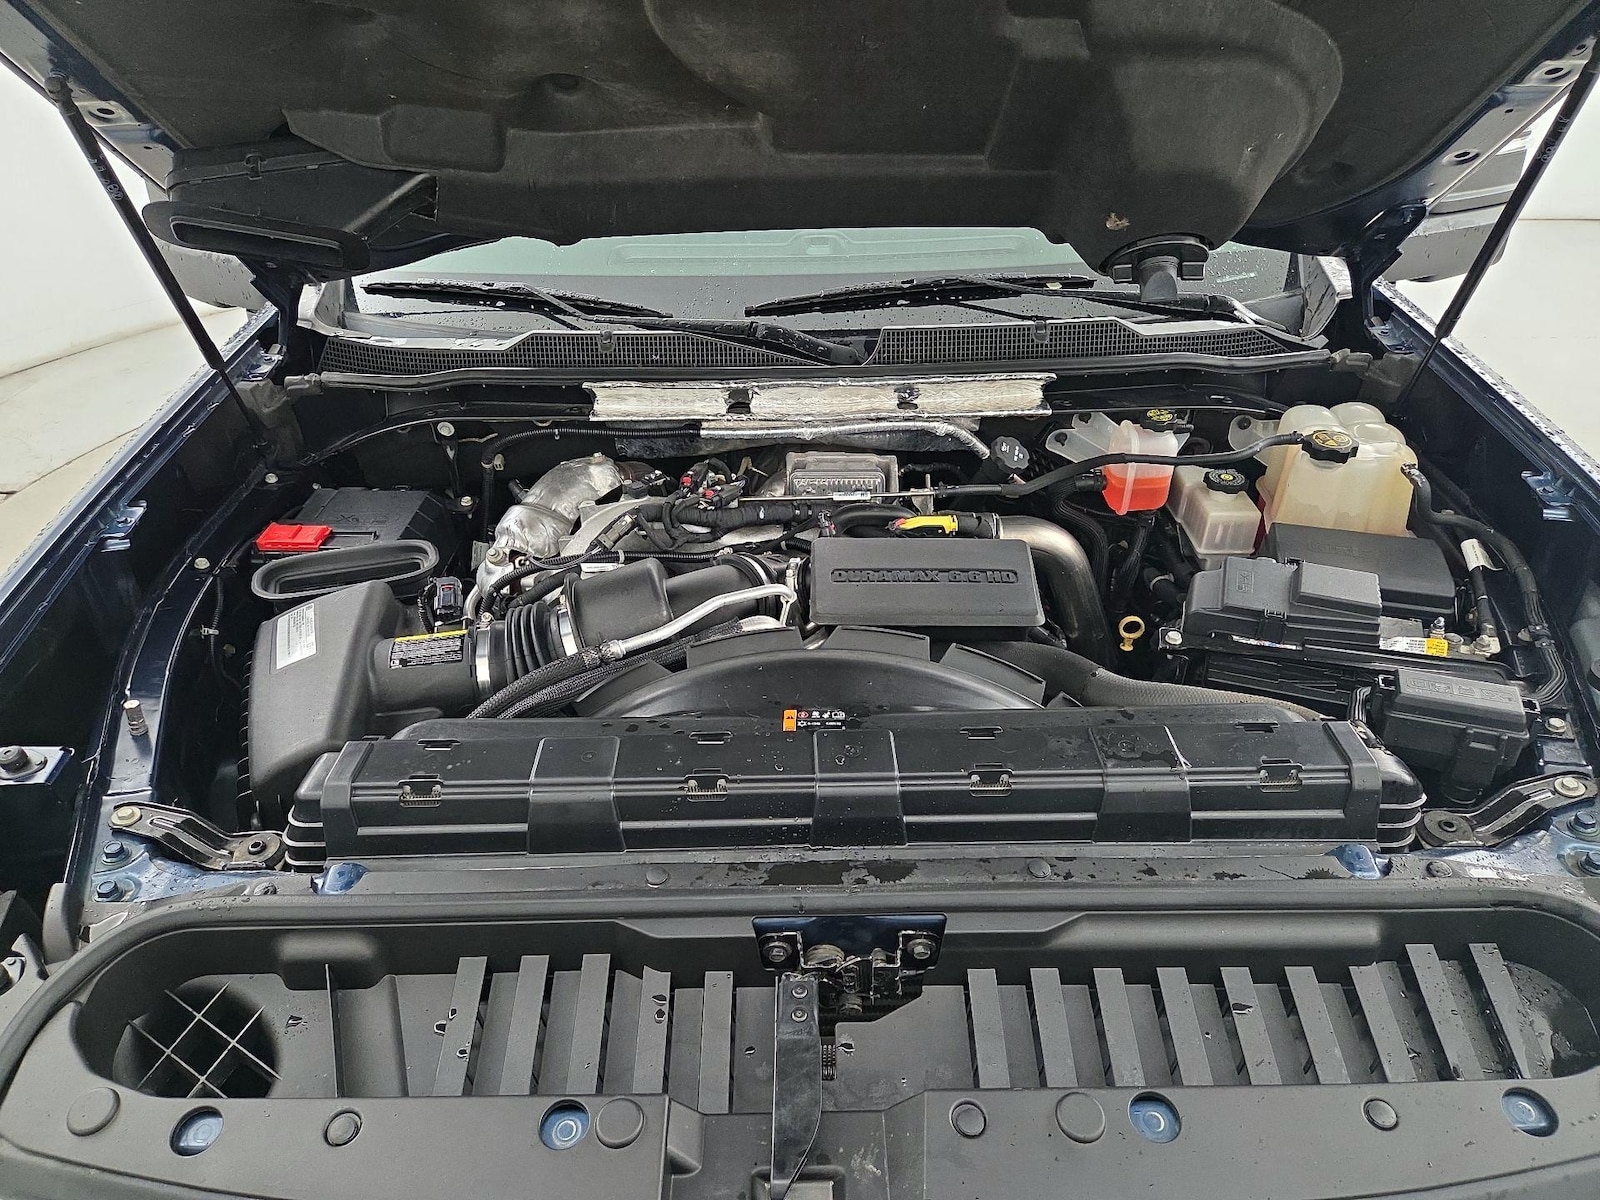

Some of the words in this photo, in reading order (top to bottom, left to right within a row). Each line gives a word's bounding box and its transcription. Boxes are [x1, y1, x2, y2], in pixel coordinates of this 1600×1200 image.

[832, 569, 940, 583] DURAMAX
[948, 569, 982, 583] 6.6
[986, 570, 1018, 584] HD
